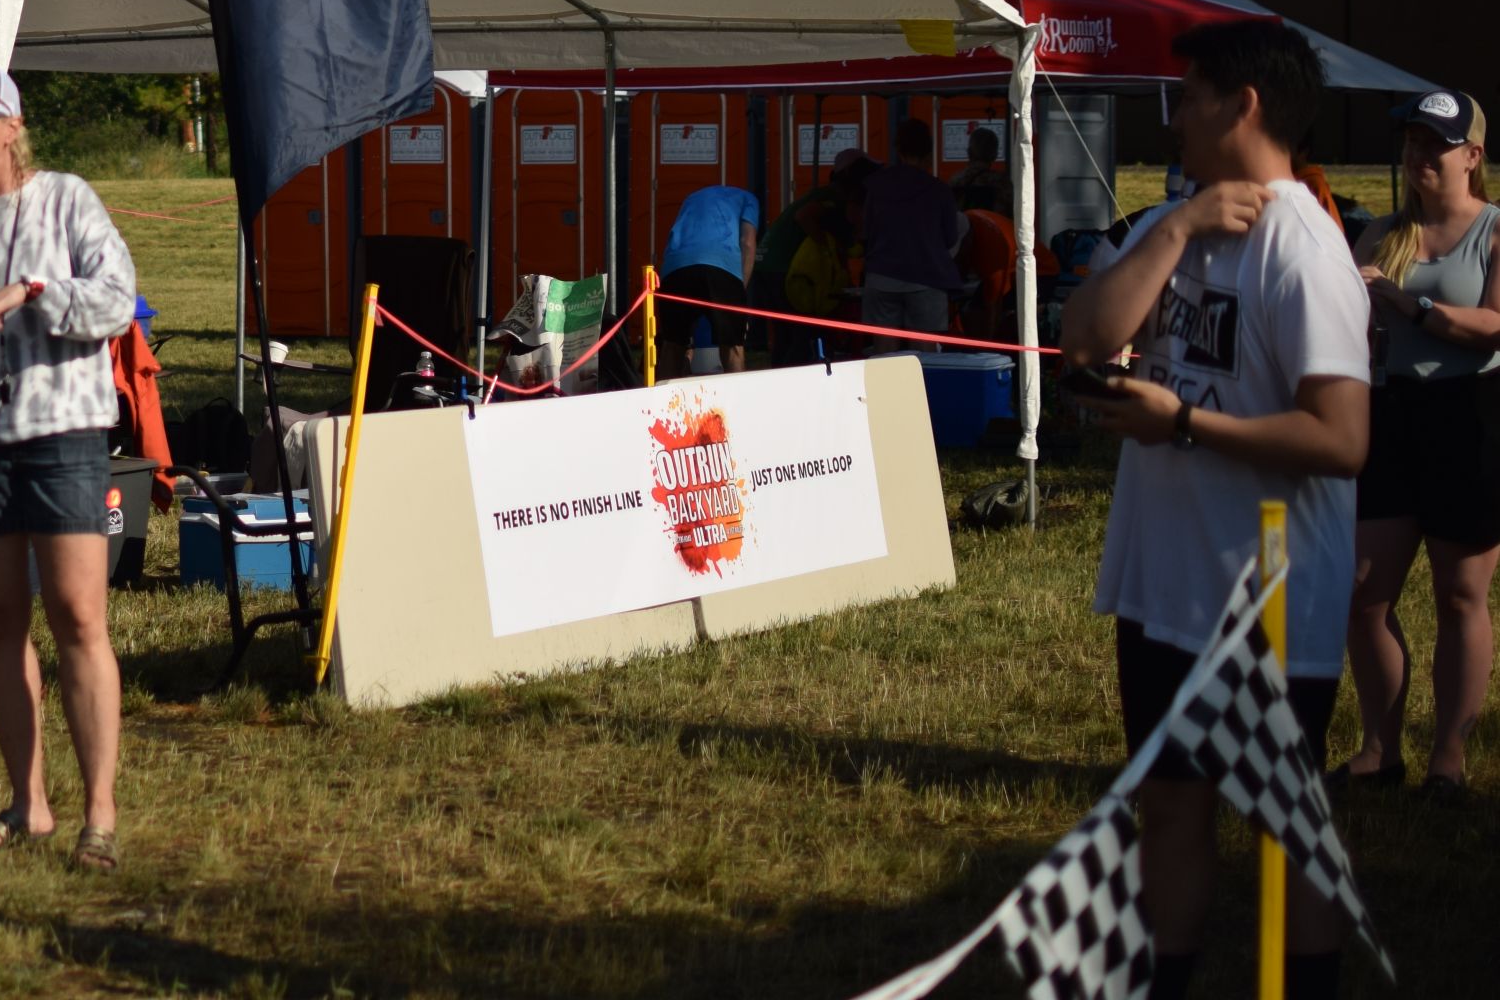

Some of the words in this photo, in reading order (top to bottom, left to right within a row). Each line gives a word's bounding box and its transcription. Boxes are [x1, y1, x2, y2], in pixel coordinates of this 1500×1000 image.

[656, 442, 734, 491] OUTRUN
[751, 468, 772, 492] JUST
[775, 464, 796, 482] ONE
[797, 459, 826, 479] MORE
[826, 455, 852, 474] LOOP
[493, 508, 533, 530] THERE
[535, 505, 547, 523] IS
[549, 502, 569, 521] NO
[572, 495, 612, 518] FINISH
[614, 490, 643, 511] LINE
[666, 484, 740, 525] BACKYARD
[693, 524, 728, 547] ULTRA
